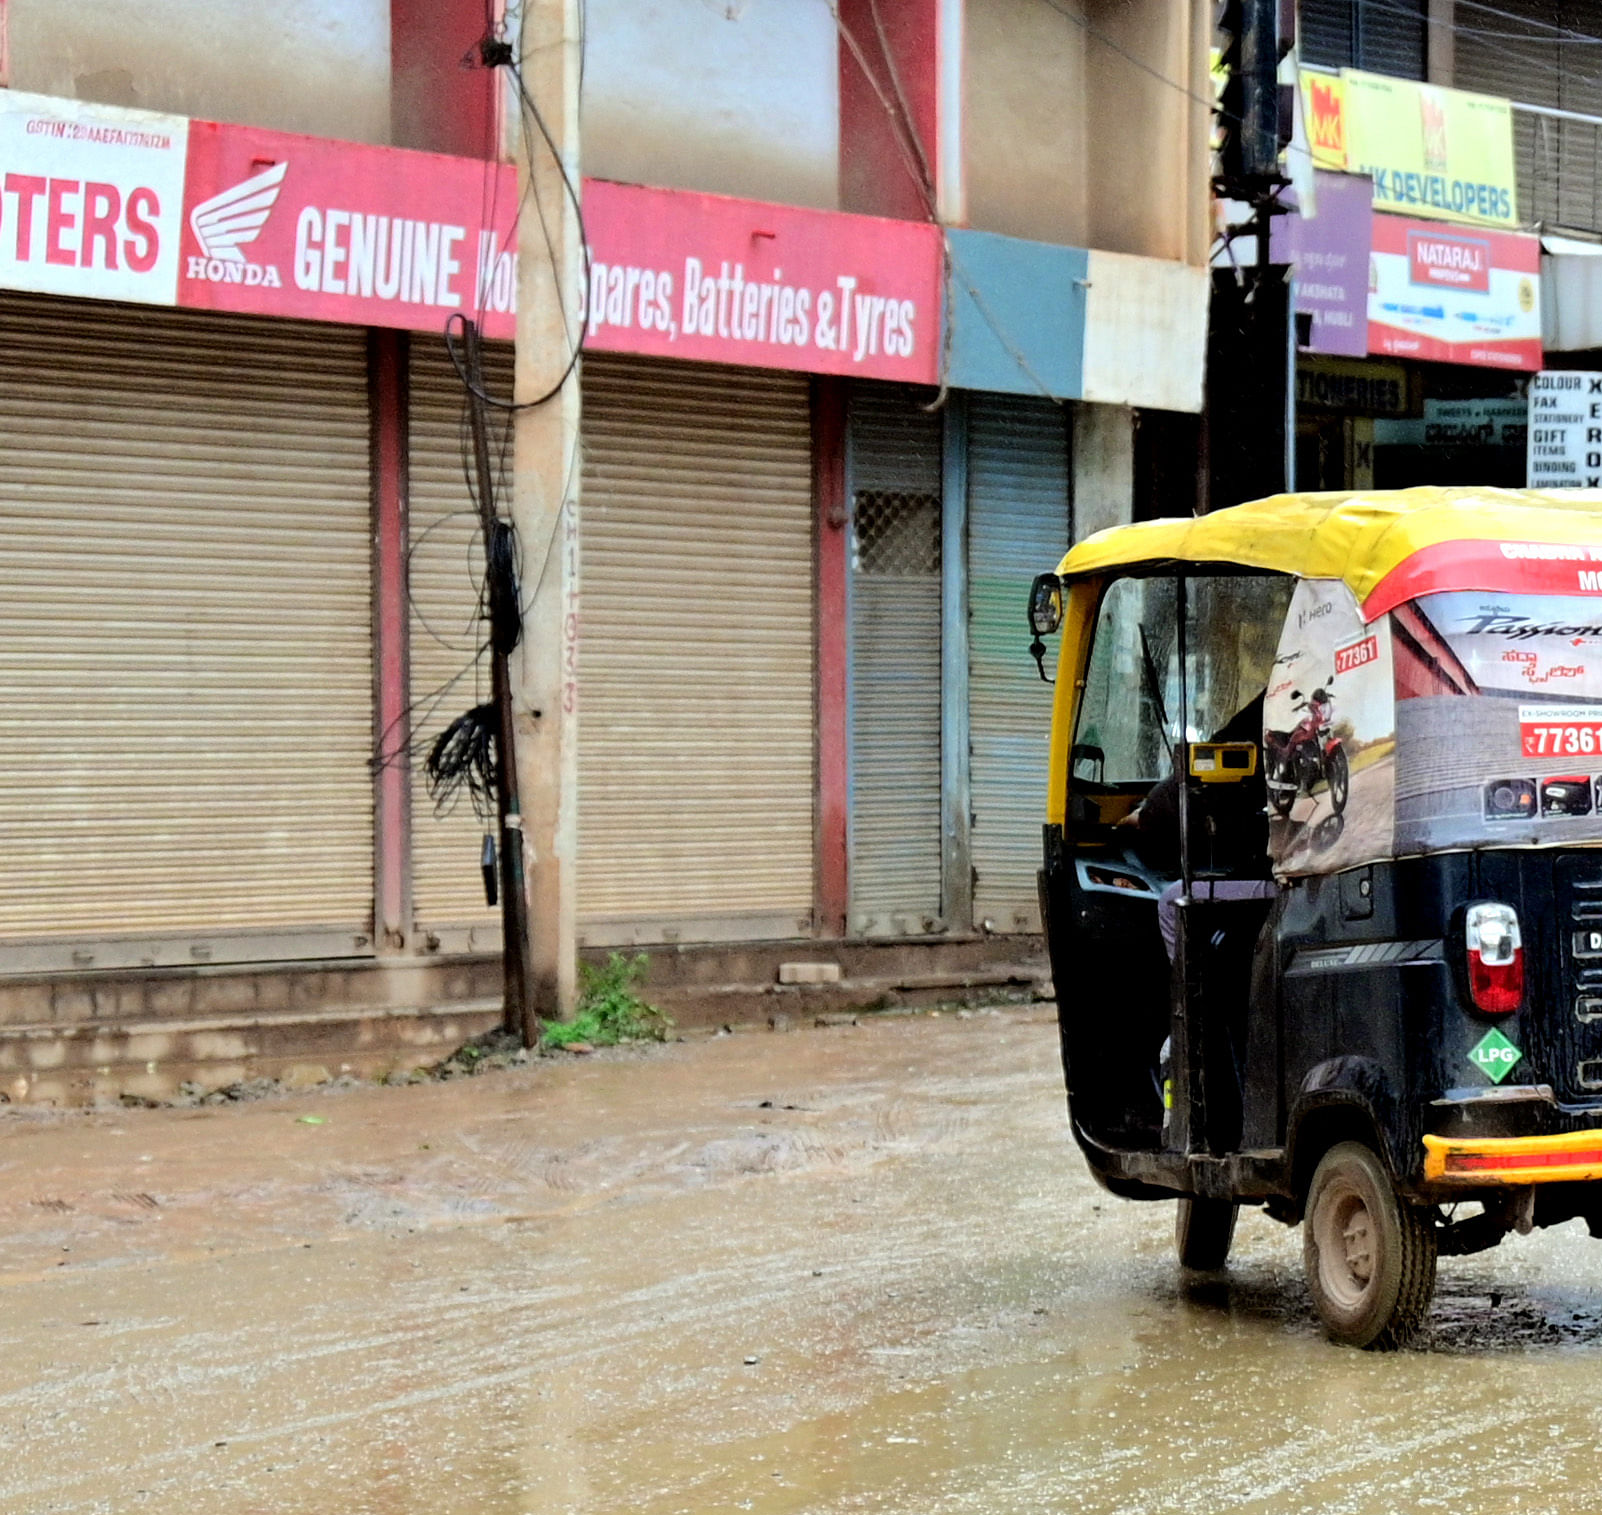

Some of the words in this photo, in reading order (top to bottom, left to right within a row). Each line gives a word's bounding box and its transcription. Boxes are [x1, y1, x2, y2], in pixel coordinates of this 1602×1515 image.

[1391, 171, 1512, 220] DEVELOPERS
[0, 172, 161, 274] TERS
[1417, 242, 1481, 270] NATARAJ
[186, 256, 283, 289] HONDA
[294, 205, 466, 308] GENUINE
[683, 256, 810, 347] Batteries
[837, 276, 916, 363] Tyres
[1533, 376, 1582, 390] COLOUR
[1533, 397, 1557, 408] FAX
[1534, 413, 1585, 424] STATIONERY
[1533, 430, 1566, 444] GIFT
[1533, 445, 1566, 456] ITEMS
[1533, 460, 1577, 474] BINDING
[1522, 709, 1587, 718] EX-SHOWROOM
[1477, 1046, 1514, 1063] LPG
